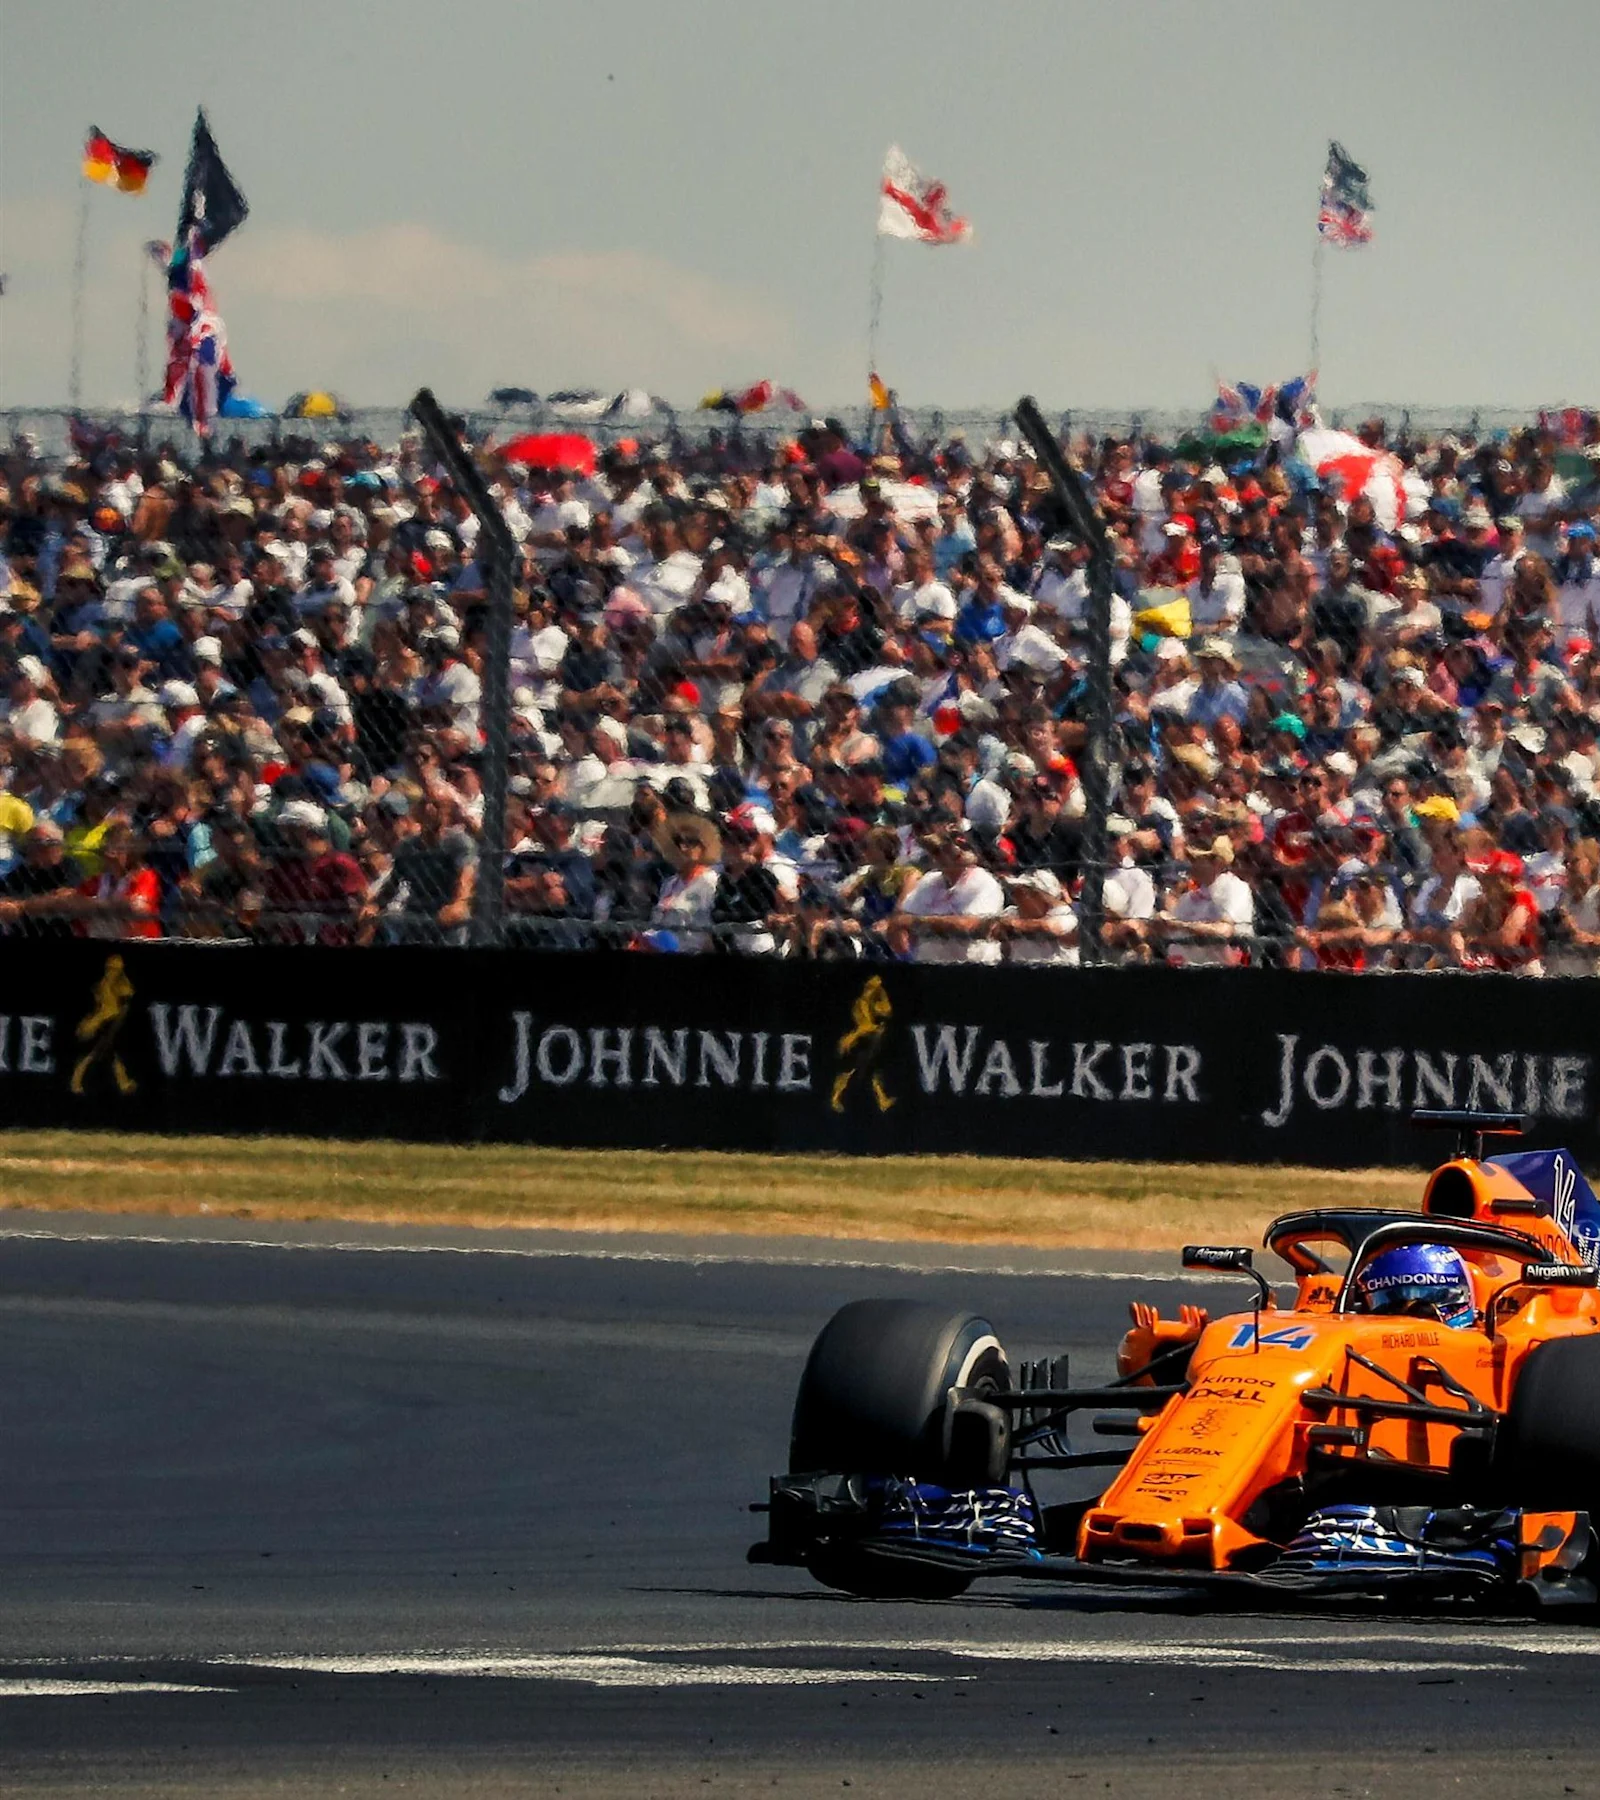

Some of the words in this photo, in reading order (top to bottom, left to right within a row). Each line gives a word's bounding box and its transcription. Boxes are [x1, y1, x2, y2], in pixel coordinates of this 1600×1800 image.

[149, 1003, 441, 1081] WALKER
[499, 1010, 813, 1103] JOHNNIE
[910, 1024, 1202, 1102] WALKER
[1261, 1033, 1591, 1128] JOHNNIE
[1367, 1273, 1438, 1291] CHANDON
[1526, 1264, 1570, 1280] Airgain
[1228, 1324, 1317, 1349] 14
[1202, 1374, 1276, 1388] kimoa
[1188, 1388, 1266, 1404] DELL
